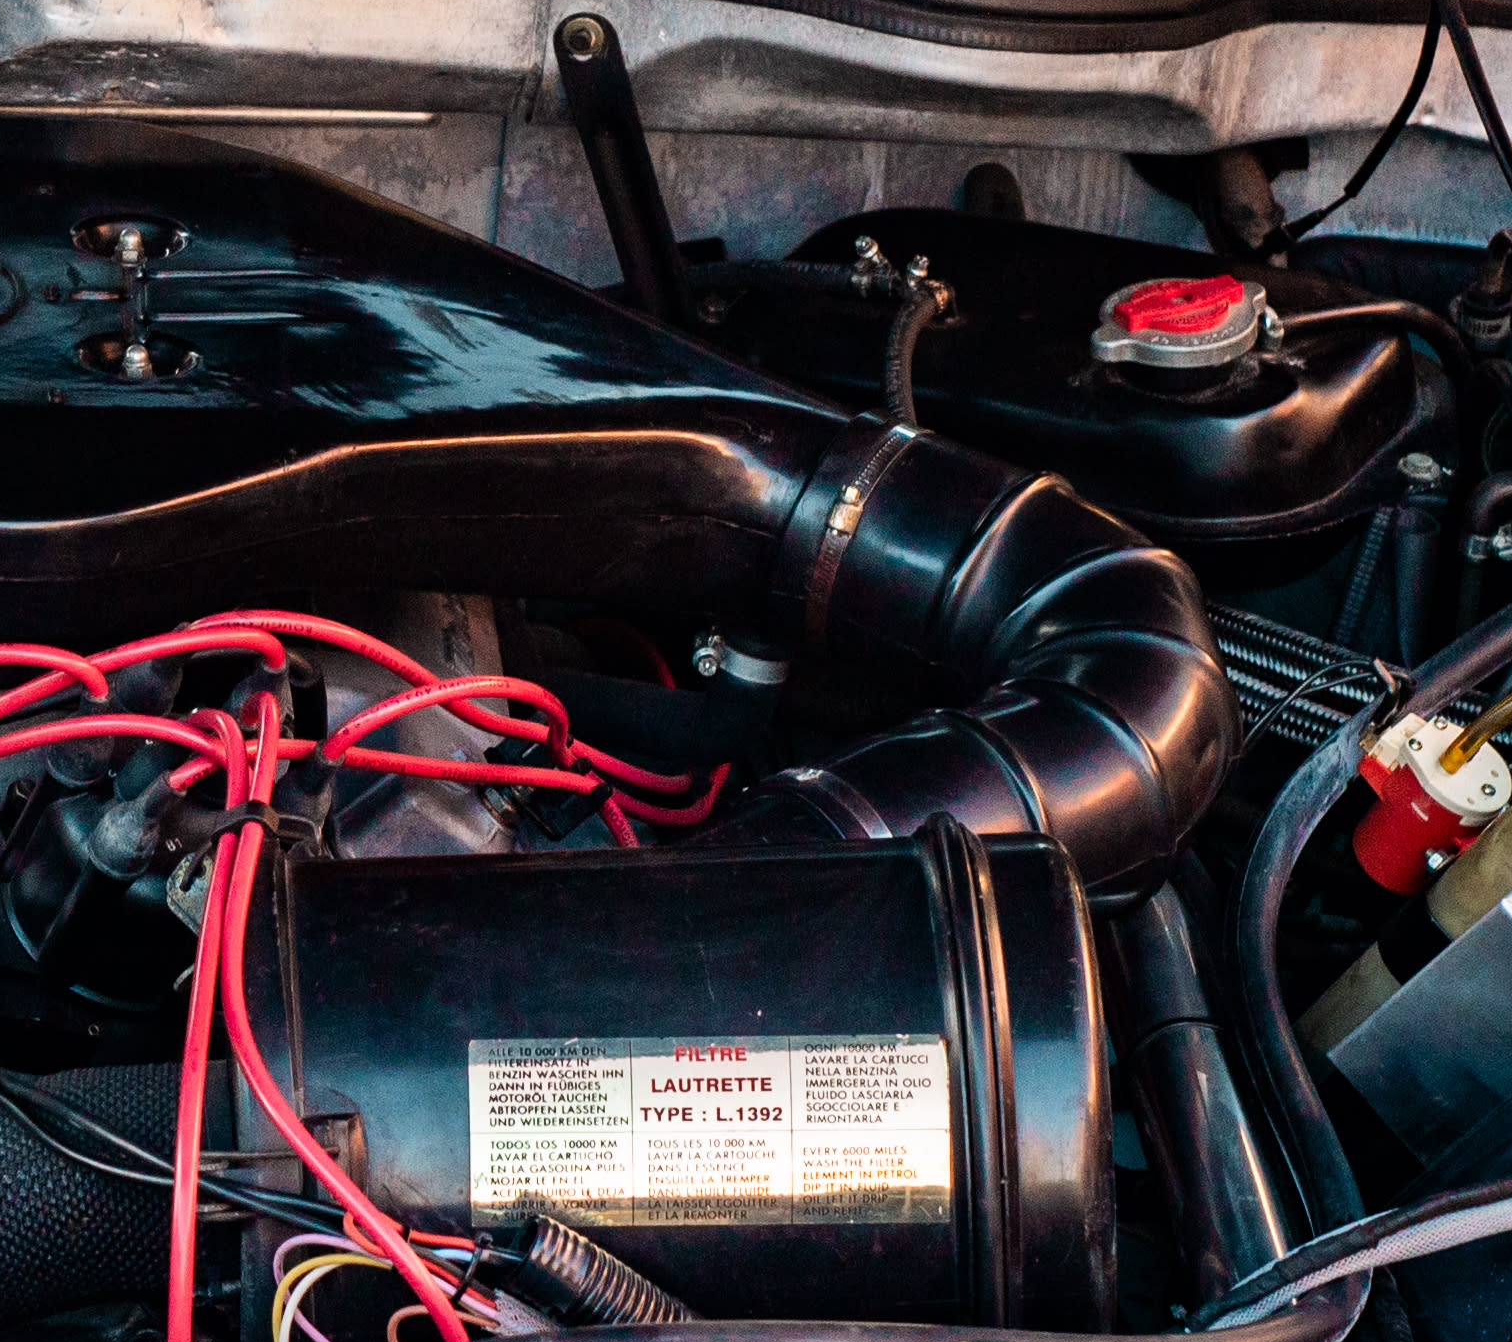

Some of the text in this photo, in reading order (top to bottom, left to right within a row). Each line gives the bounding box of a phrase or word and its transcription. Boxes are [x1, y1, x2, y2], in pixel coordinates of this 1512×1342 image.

[490, 1047, 606, 1057] ALLE 10 000 KM DEN
[805, 1044, 897, 1053] OGNI 10000 KM
[675, 1047, 747, 1062] FILTRE
[489, 1059, 589, 1067] FILTEREINSATZ IN
[805, 1056, 848, 1064] LAVARE
[854, 1056, 867, 1064] LA
[490, 1069, 623, 1079] BENZIN WASCHEN IHN
[806, 1067, 897, 1076] NELLA BENZINA
[490, 1082, 525, 1091] DANN
[530, 1082, 542, 1090] IN
[652, 1077, 772, 1093] LAUTRETTE
[806, 1078, 931, 1088] IMMERGERLA IN OLIO
[489, 1093, 608, 1103] MOTORÖL TAUCHEN
[807, 1090, 914, 1099] FLUIDO LASCIARLA
[490, 1105, 605, 1114] ABTROPFEN LASSEN
[807, 1102, 899, 1112] SGOCCIOLARE E
[640, 1108, 693, 1121] TYPE
[717, 1107, 783, 1121] L.1392
[807, 1114, 882, 1123] RIMONTARLA
[490, 1117, 628, 1127] UND WIEDEREINSETZEN
[491, 1140, 617, 1150] TODOS LOS 10000 KM
[649, 1139, 765, 1148] TOUS LES 10 000 KM
[648, 1150, 776, 1160] LAVER LA CARTOUCHE
[804, 1146, 907, 1155] EVERY 6000 MILES
[491, 1151, 613, 1161] LAVAR EL CARTUCHO
[687, 1163, 745, 1172] LESSENCE
[804, 1159, 903, 1167] WASH THE FILTER
[491, 1165, 506, 1173] EN
[512, 1165, 524, 1173] LA
[530, 1164, 591, 1173] GASOLINA
[721, 1175, 770, 1183] TREMPER
[804, 1171, 853, 1180] ELEMENT
[878, 1170, 918, 1179] PETROL
[491, 1177, 531, 1185] MOJAR
[804, 1183, 889, 1192] DIP IT IN FLUID
[648, 1200, 662, 1208] LA
[667, 1199, 711, 1208] LAISSER
[803, 1194, 888, 1204] OIL LET IT DRIP
[551, 1201, 557, 1209] Y
[563, 1200, 607, 1209] VOLVER
[649, 1210, 747, 1220] ET LA REMONTER
[804, 1207, 829, 1216] AND
